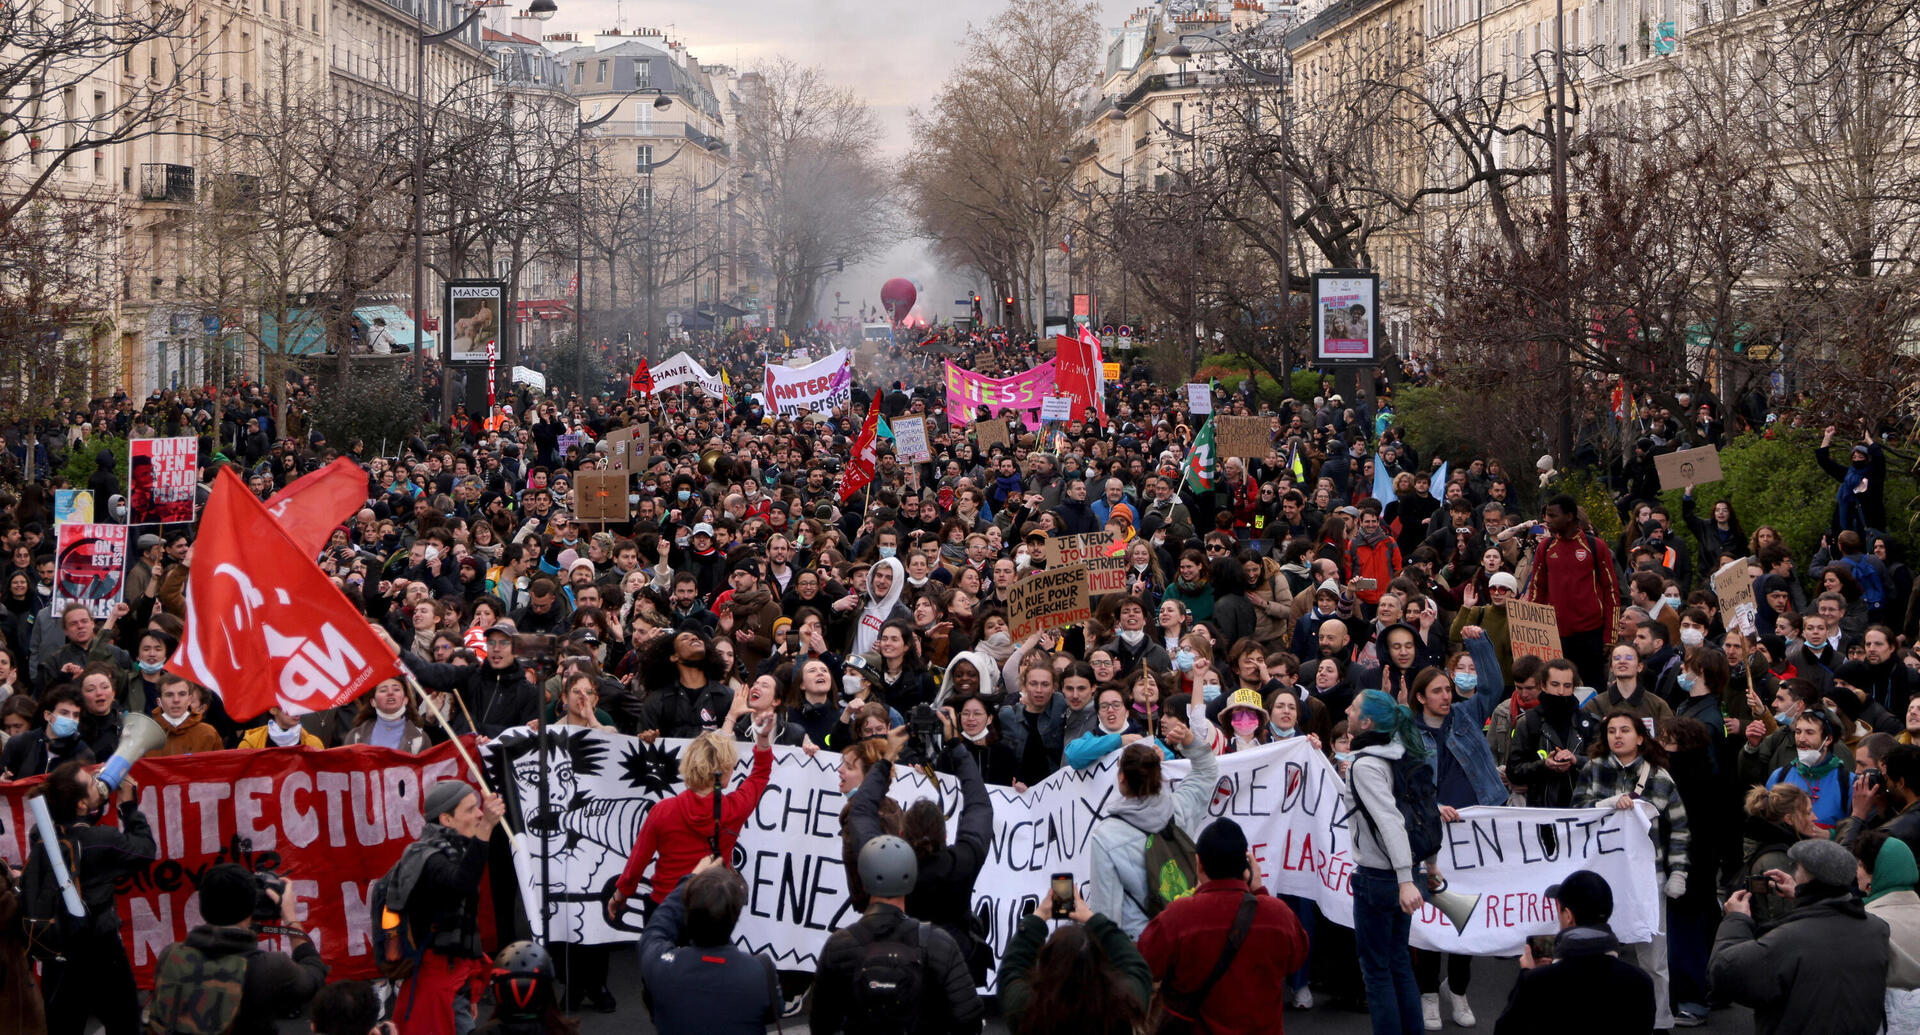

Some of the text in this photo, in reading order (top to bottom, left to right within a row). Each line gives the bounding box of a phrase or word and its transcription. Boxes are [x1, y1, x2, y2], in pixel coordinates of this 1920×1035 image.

[453, 288, 500, 297] MANGO
[948, 364, 1034, 406] EHESS
[152, 437, 197, 456] ON NE
[152, 470, 194, 487] TEND
[84, 526, 124, 539] NOUS
[1058, 532, 1114, 550] JE VEUX
[94, 540, 111, 553] ON
[1060, 545, 1104, 564] JOUIR
[91, 555, 110, 566] EST
[1009, 568, 1085, 604] ON TRAVERSE
[1010, 584, 1078, 617] LA RUE POUR
[1025, 598, 1077, 620] CHERCHER
[1011, 607, 1091, 642] NOS RETRAITES
[1511, 624, 1550, 647] ARTISTES
[1281, 761, 1326, 818] DU
[1446, 817, 1504, 871] EN
[1518, 813, 1625, 864] LUTTE
[1283, 829, 1315, 872] LA
